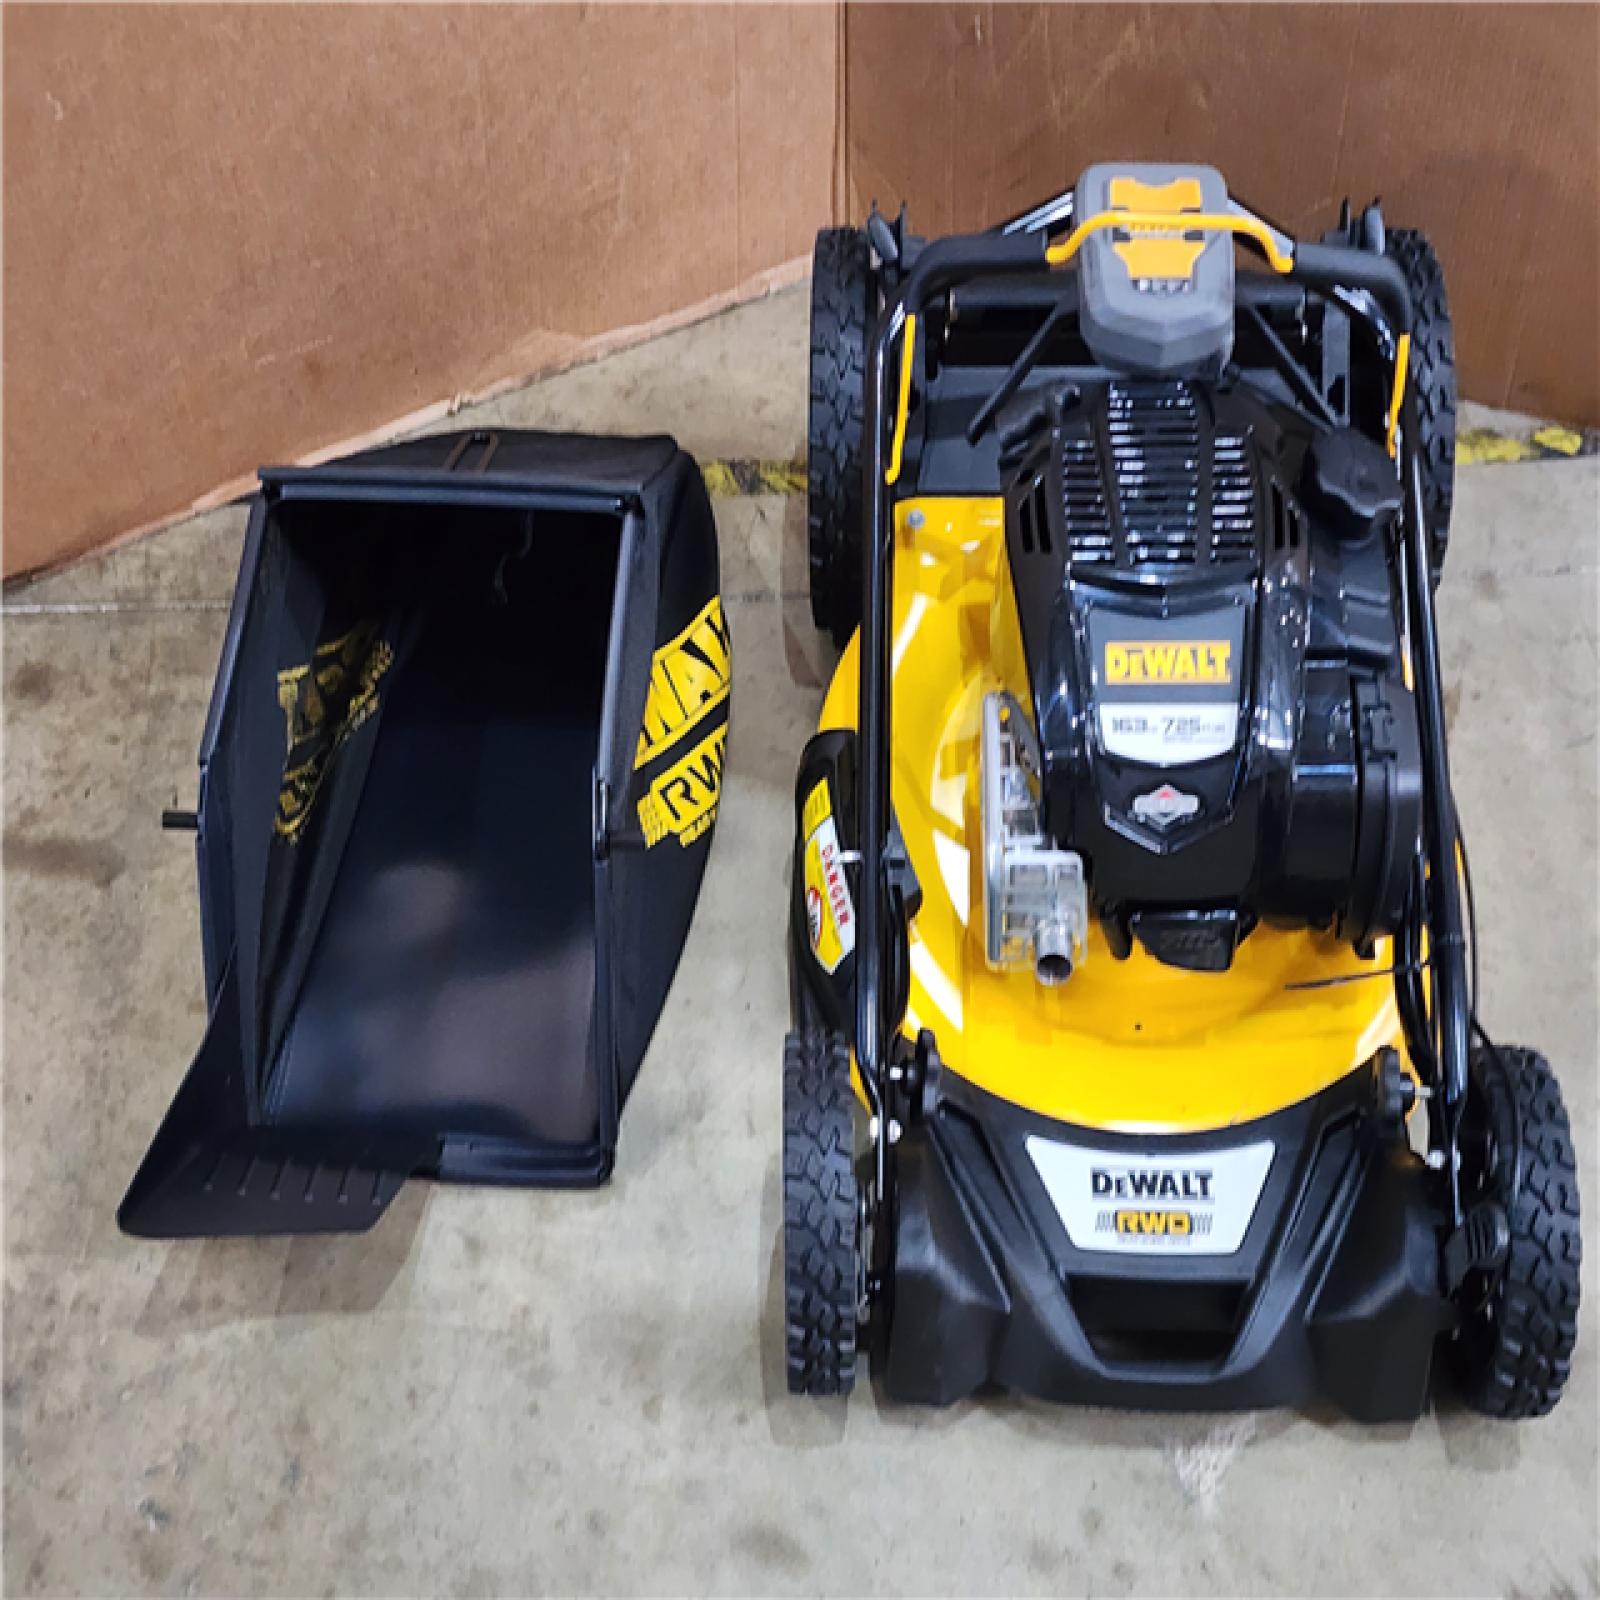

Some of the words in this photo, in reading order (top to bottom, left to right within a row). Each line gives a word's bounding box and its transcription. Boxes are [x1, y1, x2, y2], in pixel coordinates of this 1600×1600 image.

[658, 734, 726, 821] RW
[821, 844, 850, 926] DANGER
[1115, 1210, 1192, 1234] RWD
